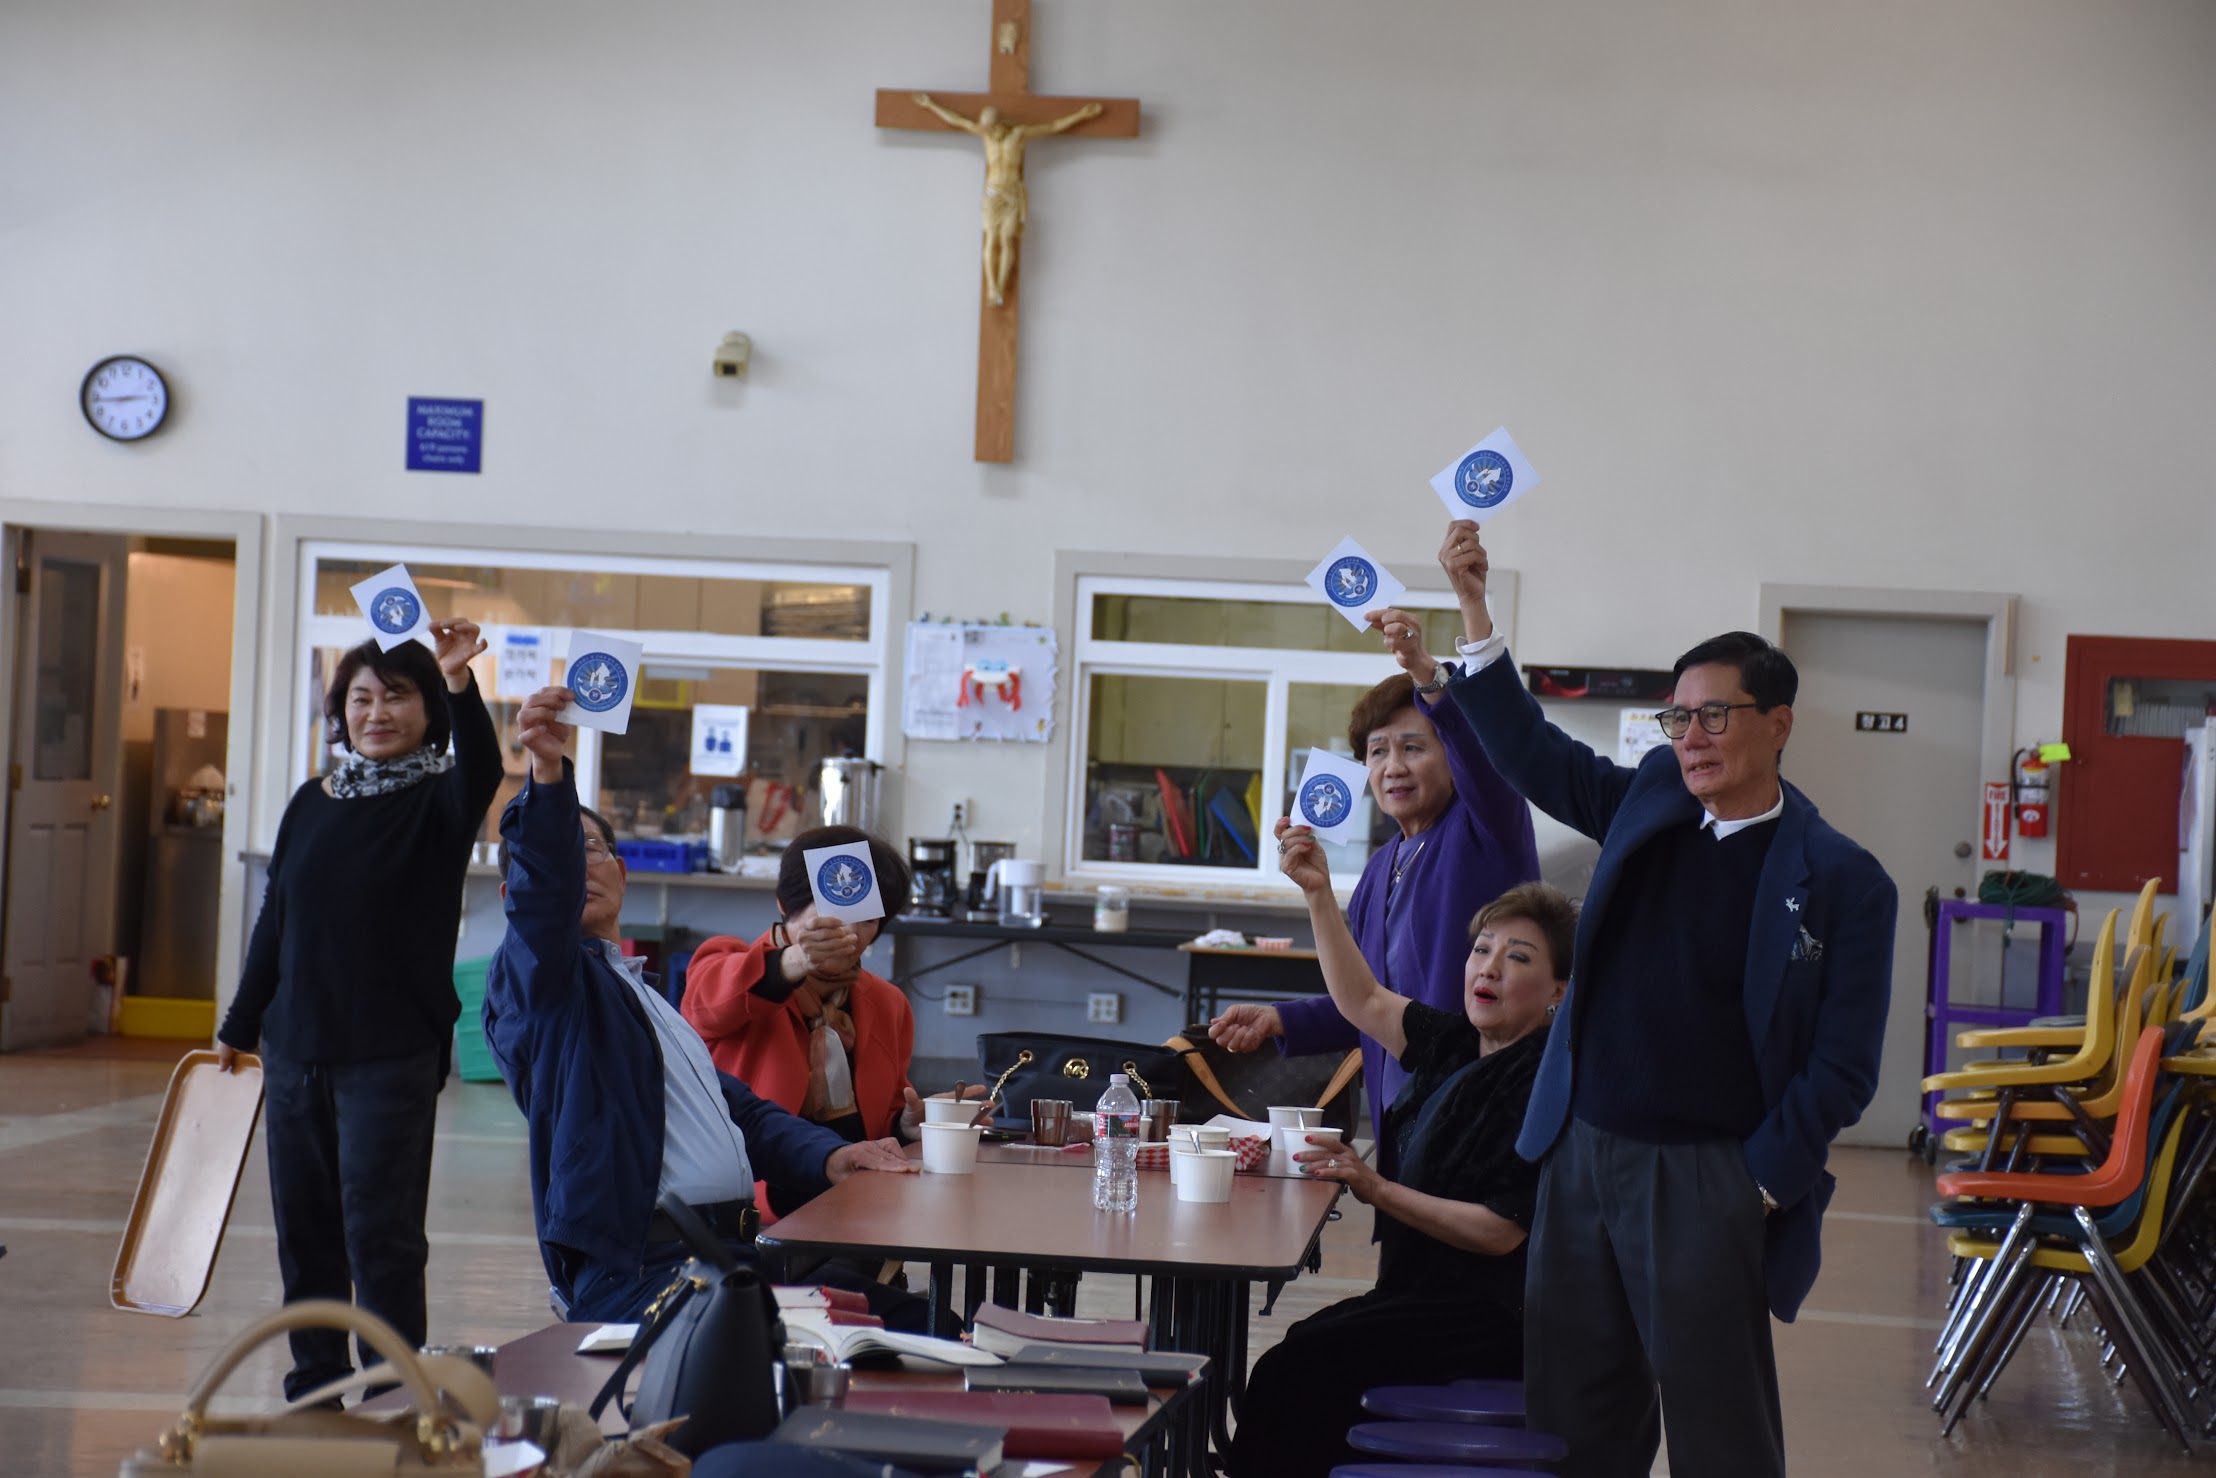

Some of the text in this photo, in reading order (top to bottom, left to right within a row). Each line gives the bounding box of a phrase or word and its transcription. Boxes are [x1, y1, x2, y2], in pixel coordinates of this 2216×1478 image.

[122, 365, 132, 376] 12
[98, 376, 108, 387] 10
[147, 379, 155, 390] 2
[153, 394, 159, 404] 3
[96, 406, 104, 417] 8
[145, 410, 153, 419] 4
[416, 404, 474, 417] MAXIMUM
[108, 415, 115, 428] 7
[121, 419, 128, 430] 6
[136, 417, 144, 429] 5
[426, 416, 463, 428] ROOM
[1989, 790, 2006, 801] FIRE
